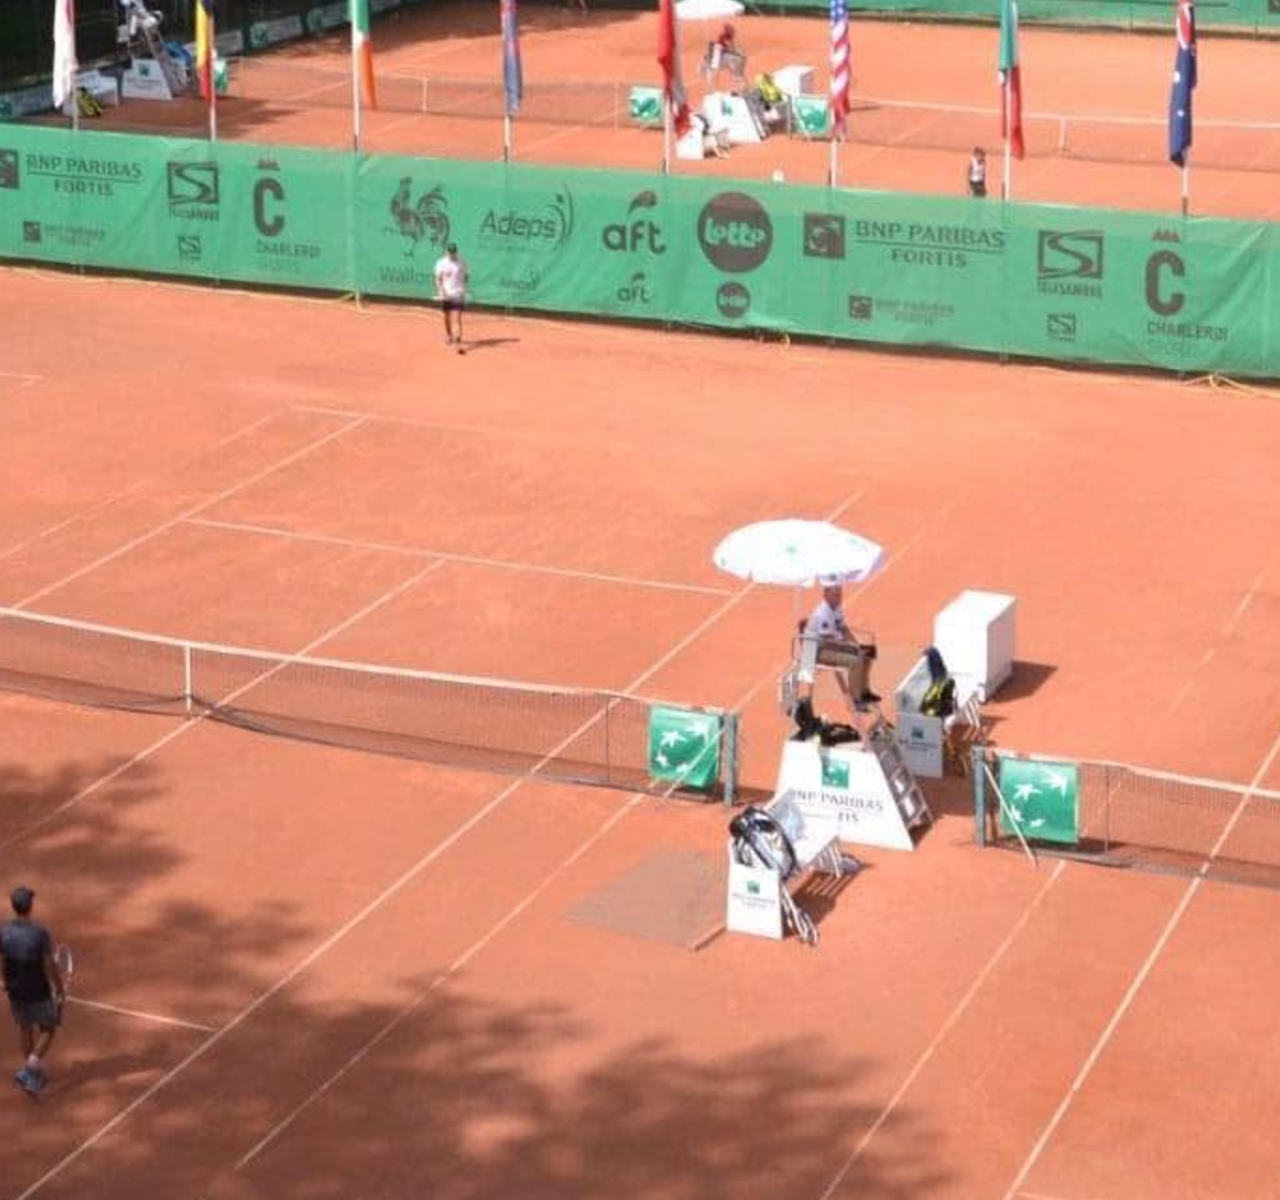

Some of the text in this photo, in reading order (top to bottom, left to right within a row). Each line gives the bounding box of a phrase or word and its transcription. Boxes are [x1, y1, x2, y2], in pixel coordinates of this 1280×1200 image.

[26, 153, 143, 179] BNP PARIBAS
[479, 210, 556, 240] Adeps
[602, 220, 666, 255] aft
[855, 219, 1006, 249] BNP PARIBAS
[891, 248, 968, 268] FORTIS
